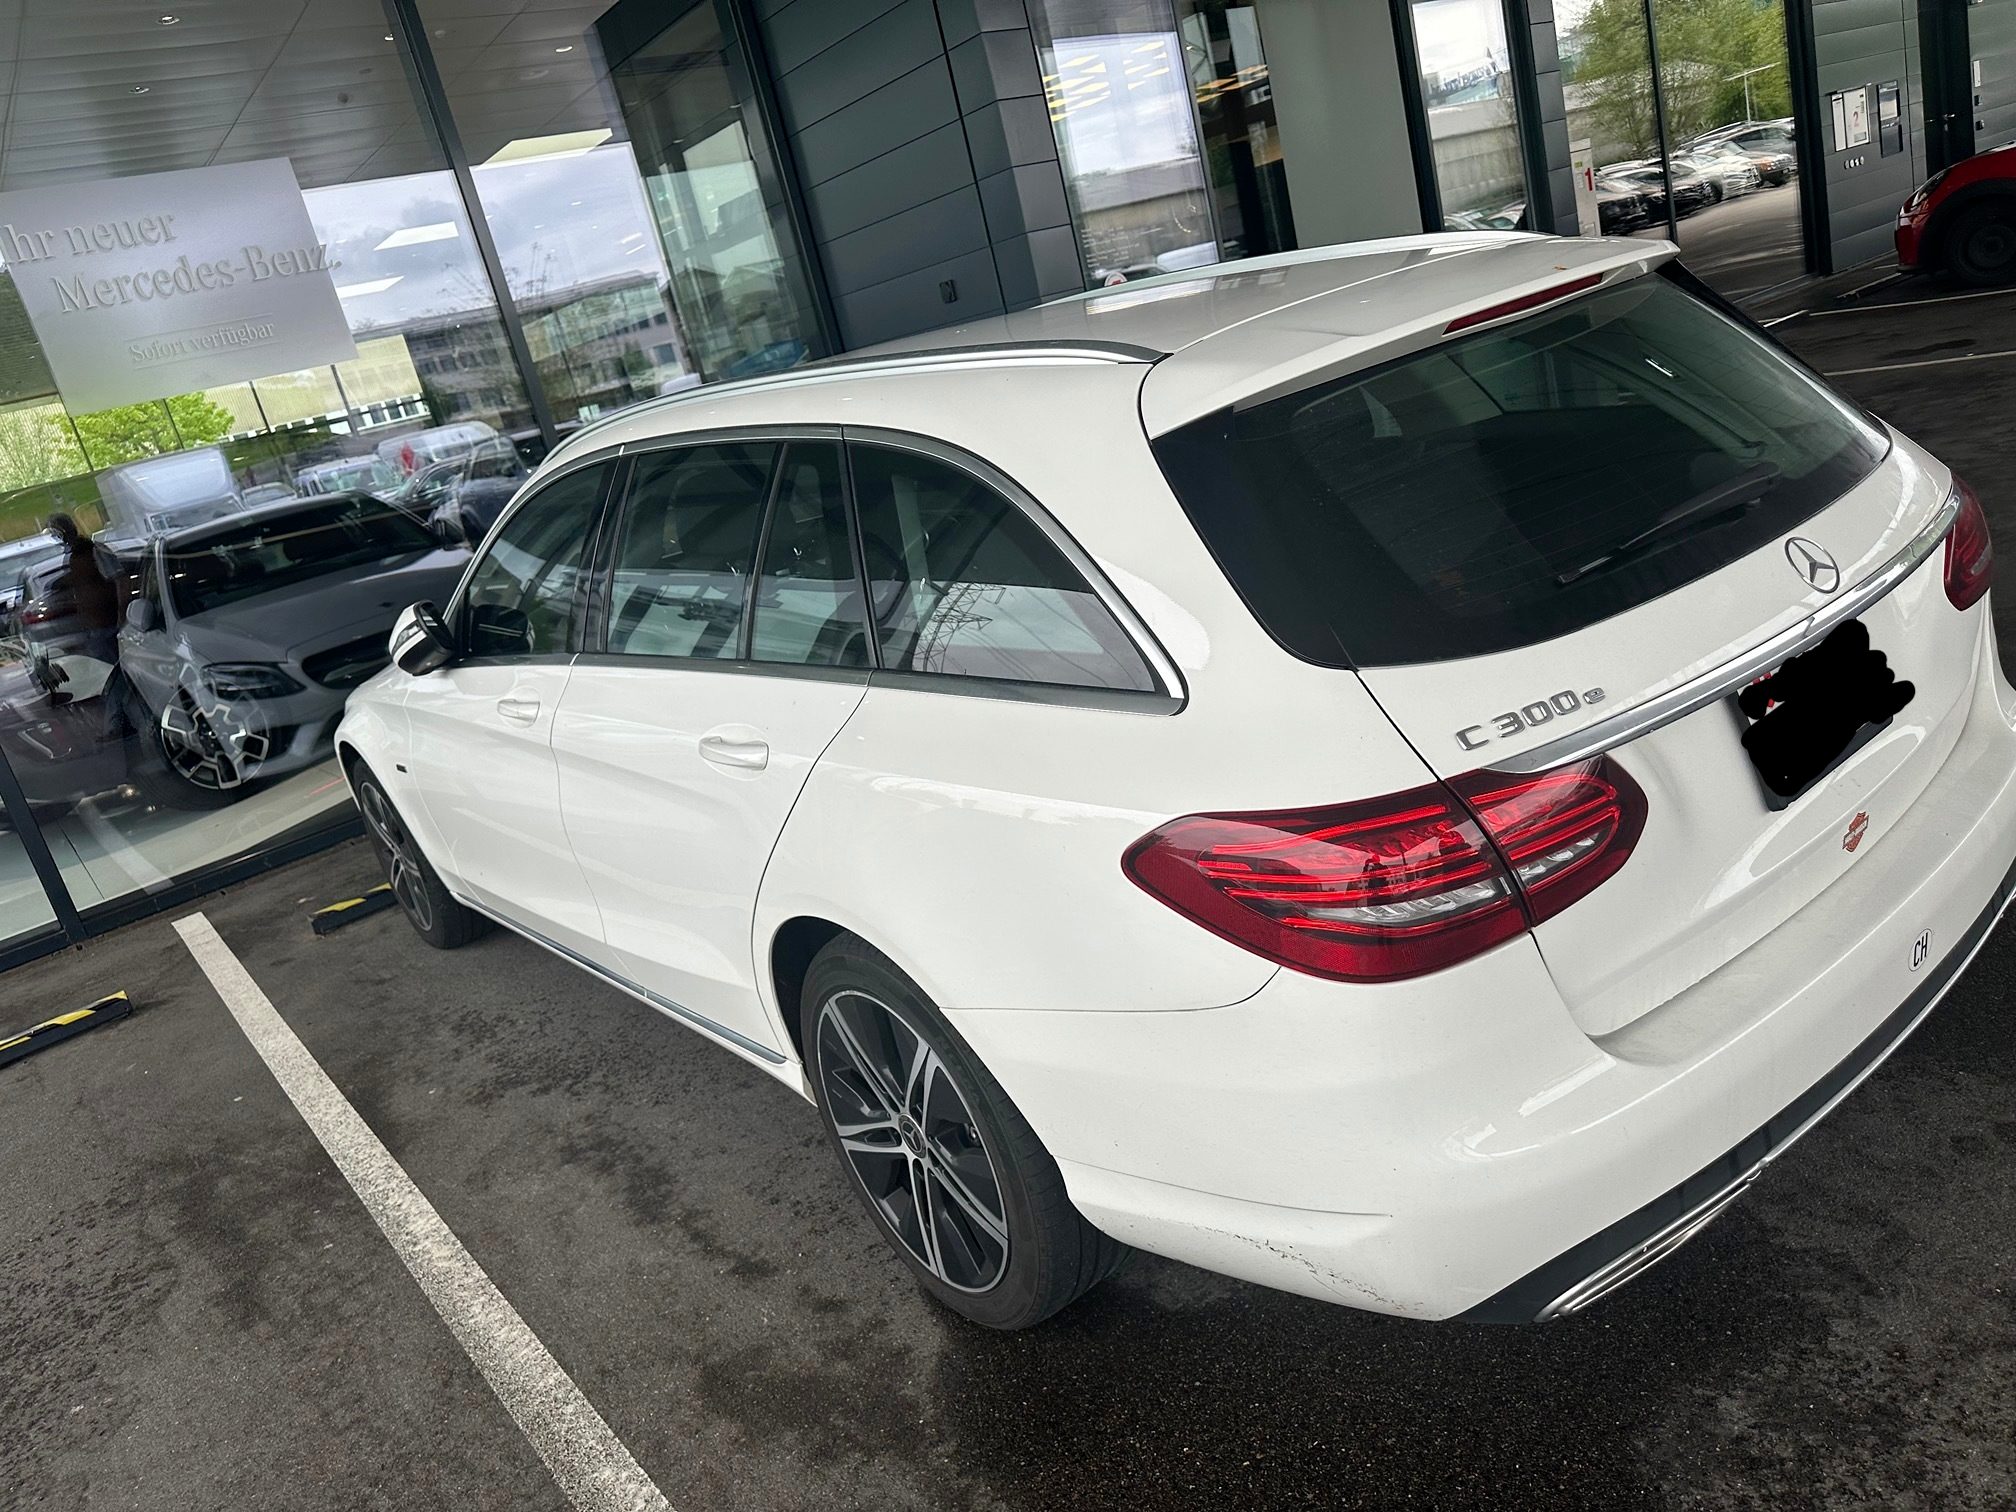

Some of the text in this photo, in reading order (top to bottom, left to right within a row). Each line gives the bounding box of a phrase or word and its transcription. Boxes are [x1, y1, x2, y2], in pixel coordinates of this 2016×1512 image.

[1853, 111, 1860, 128] 2
[1584, 168, 1593, 191] 1
[0, 214, 177, 264] Ihr neuer
[50, 243, 343, 314] Mercedes-Benz.
[129, 322, 275, 363] Sofort verfügbar
[1455, 724, 1490, 751] C
[1913, 931, 1929, 968] CH
